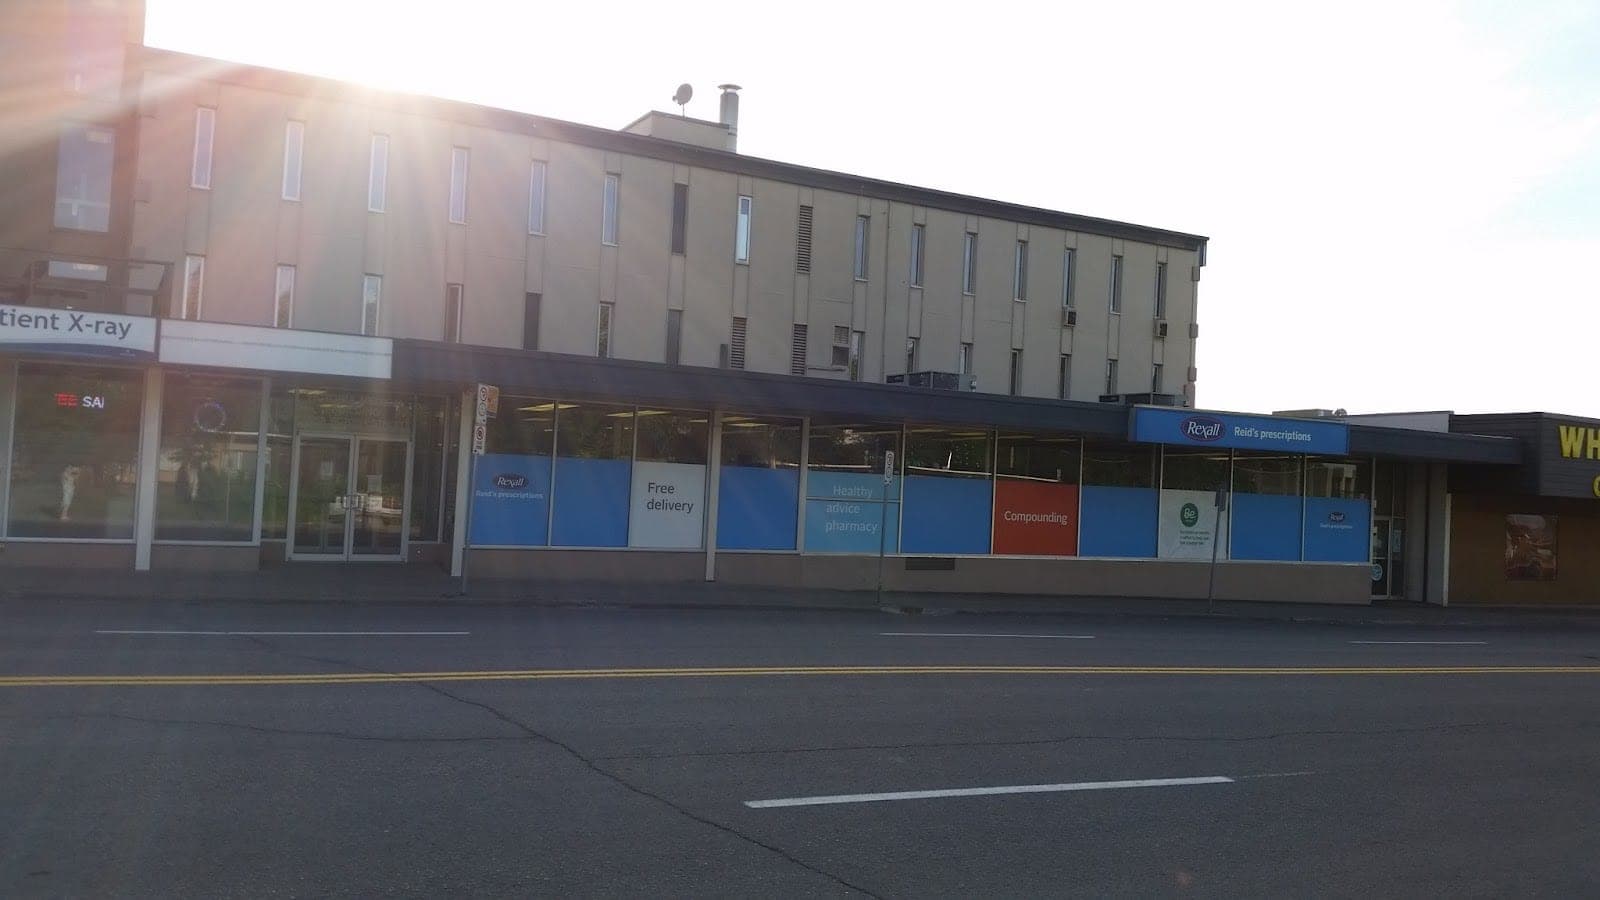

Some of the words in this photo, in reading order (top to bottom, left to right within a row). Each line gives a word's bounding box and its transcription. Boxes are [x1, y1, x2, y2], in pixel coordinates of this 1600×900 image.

[68, 313, 132, 340] X-ray
[1187, 421, 1220, 438] Rexall
[1234, 427, 1260, 438] Reid's
[1260, 430, 1312, 443] prescriptions
[497, 476, 525, 488] Rexall
[648, 482, 675, 495] Free
[833, 484, 873, 499] Healthy
[646, 500, 694, 514] delivery
[826, 503, 861, 515] advice
[1004, 510, 1068, 526] Compounding
[825, 519, 878, 534] pharmacy
